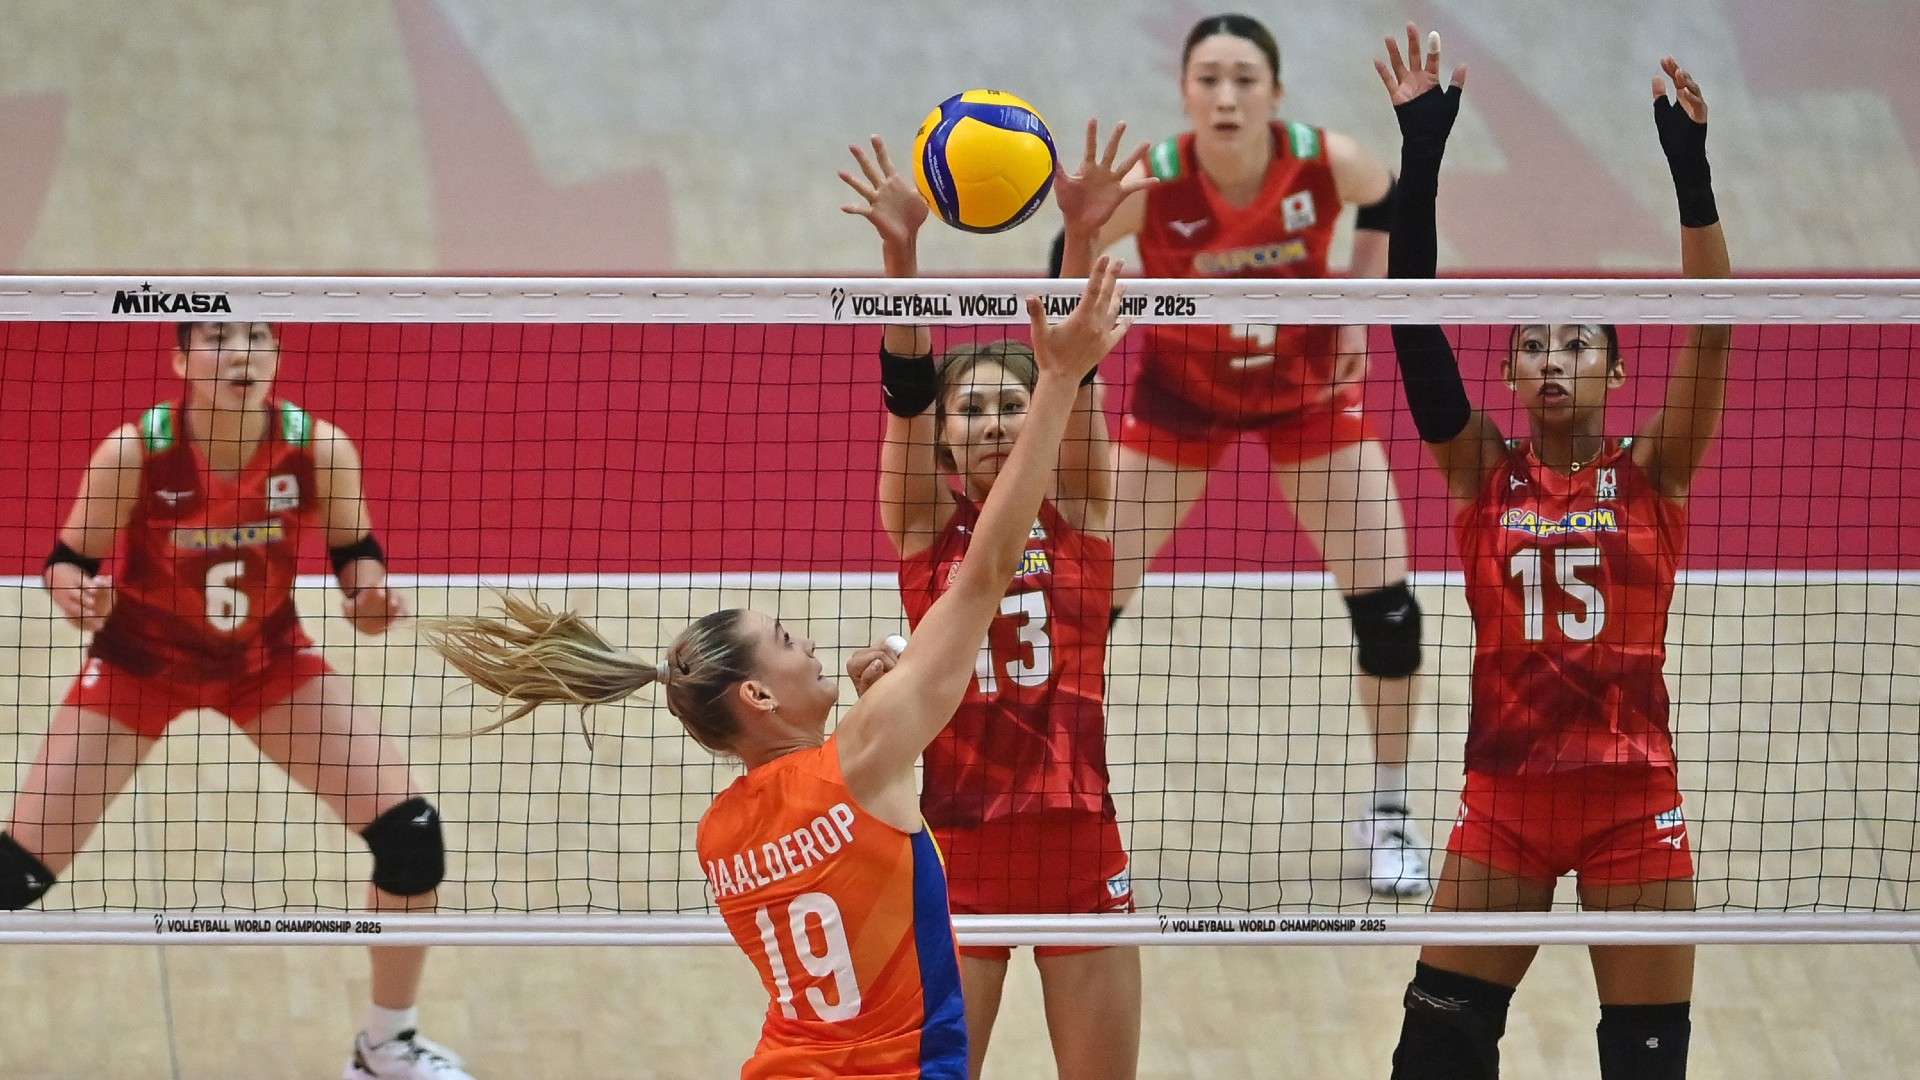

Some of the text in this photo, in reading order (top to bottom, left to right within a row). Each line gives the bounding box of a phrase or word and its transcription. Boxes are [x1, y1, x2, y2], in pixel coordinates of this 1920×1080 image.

[851, 295, 952, 317] VOLLEYBALL
[959, 294, 1018, 317] WORLD
[1154, 295, 1196, 317] 2025
[1500, 507, 1618, 538] CAPCOM
[205, 560, 249, 632] 6
[1510, 547, 1606, 641] 15
[168, 919, 382, 934] VOLLEYBALL WORLD CHAMPIONSHIP 2025
[1172, 919, 1386, 932] VOLLEYBALL WORLD CHAMPIONSHIP 2025
[755, 892, 862, 1023] 19
